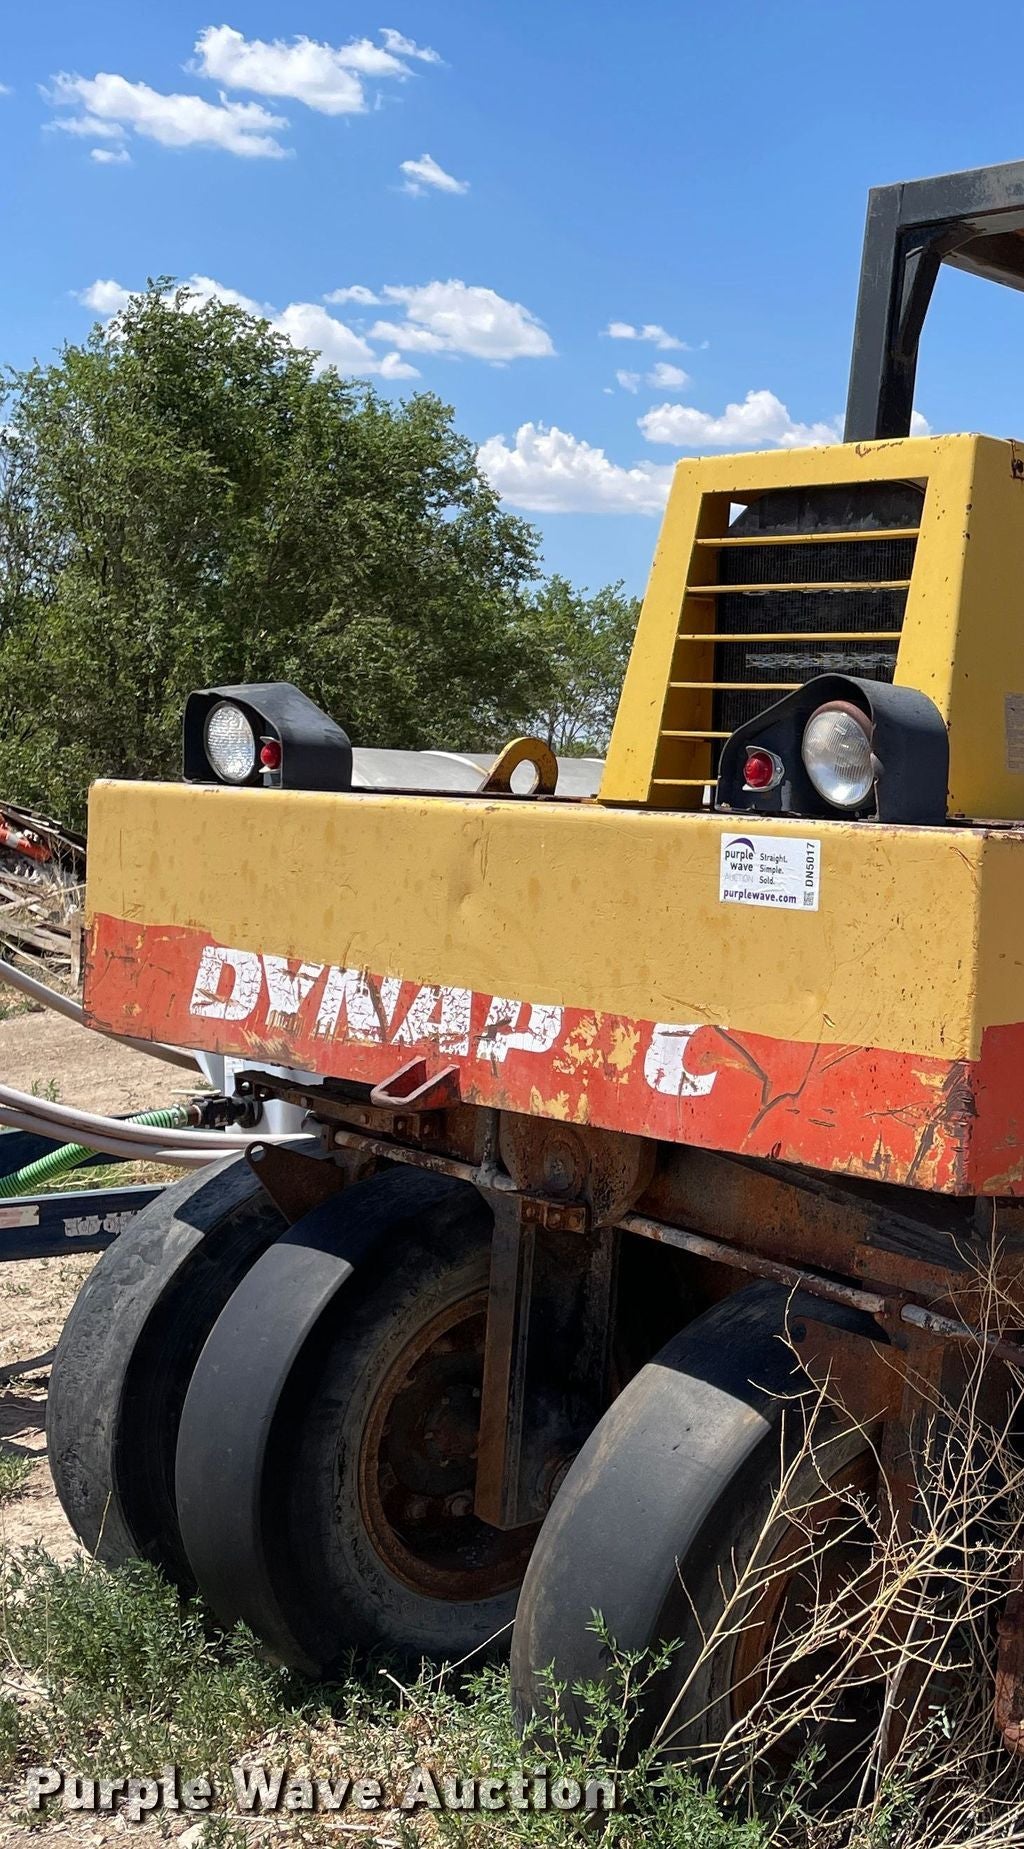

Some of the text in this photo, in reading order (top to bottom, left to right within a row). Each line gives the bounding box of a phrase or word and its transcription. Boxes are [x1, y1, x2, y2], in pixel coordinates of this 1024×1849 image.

[725, 849, 754, 860] purple
[760, 853, 788, 864] Straight.
[730, 862, 754, 872] wave
[759, 864, 784, 874] Simple.
[805, 842, 815, 887] DN5017
[759, 875, 776, 885] Sold.
[723, 889, 797, 903] purplewave.com
[190, 945, 728, 1097] DYNAPC
